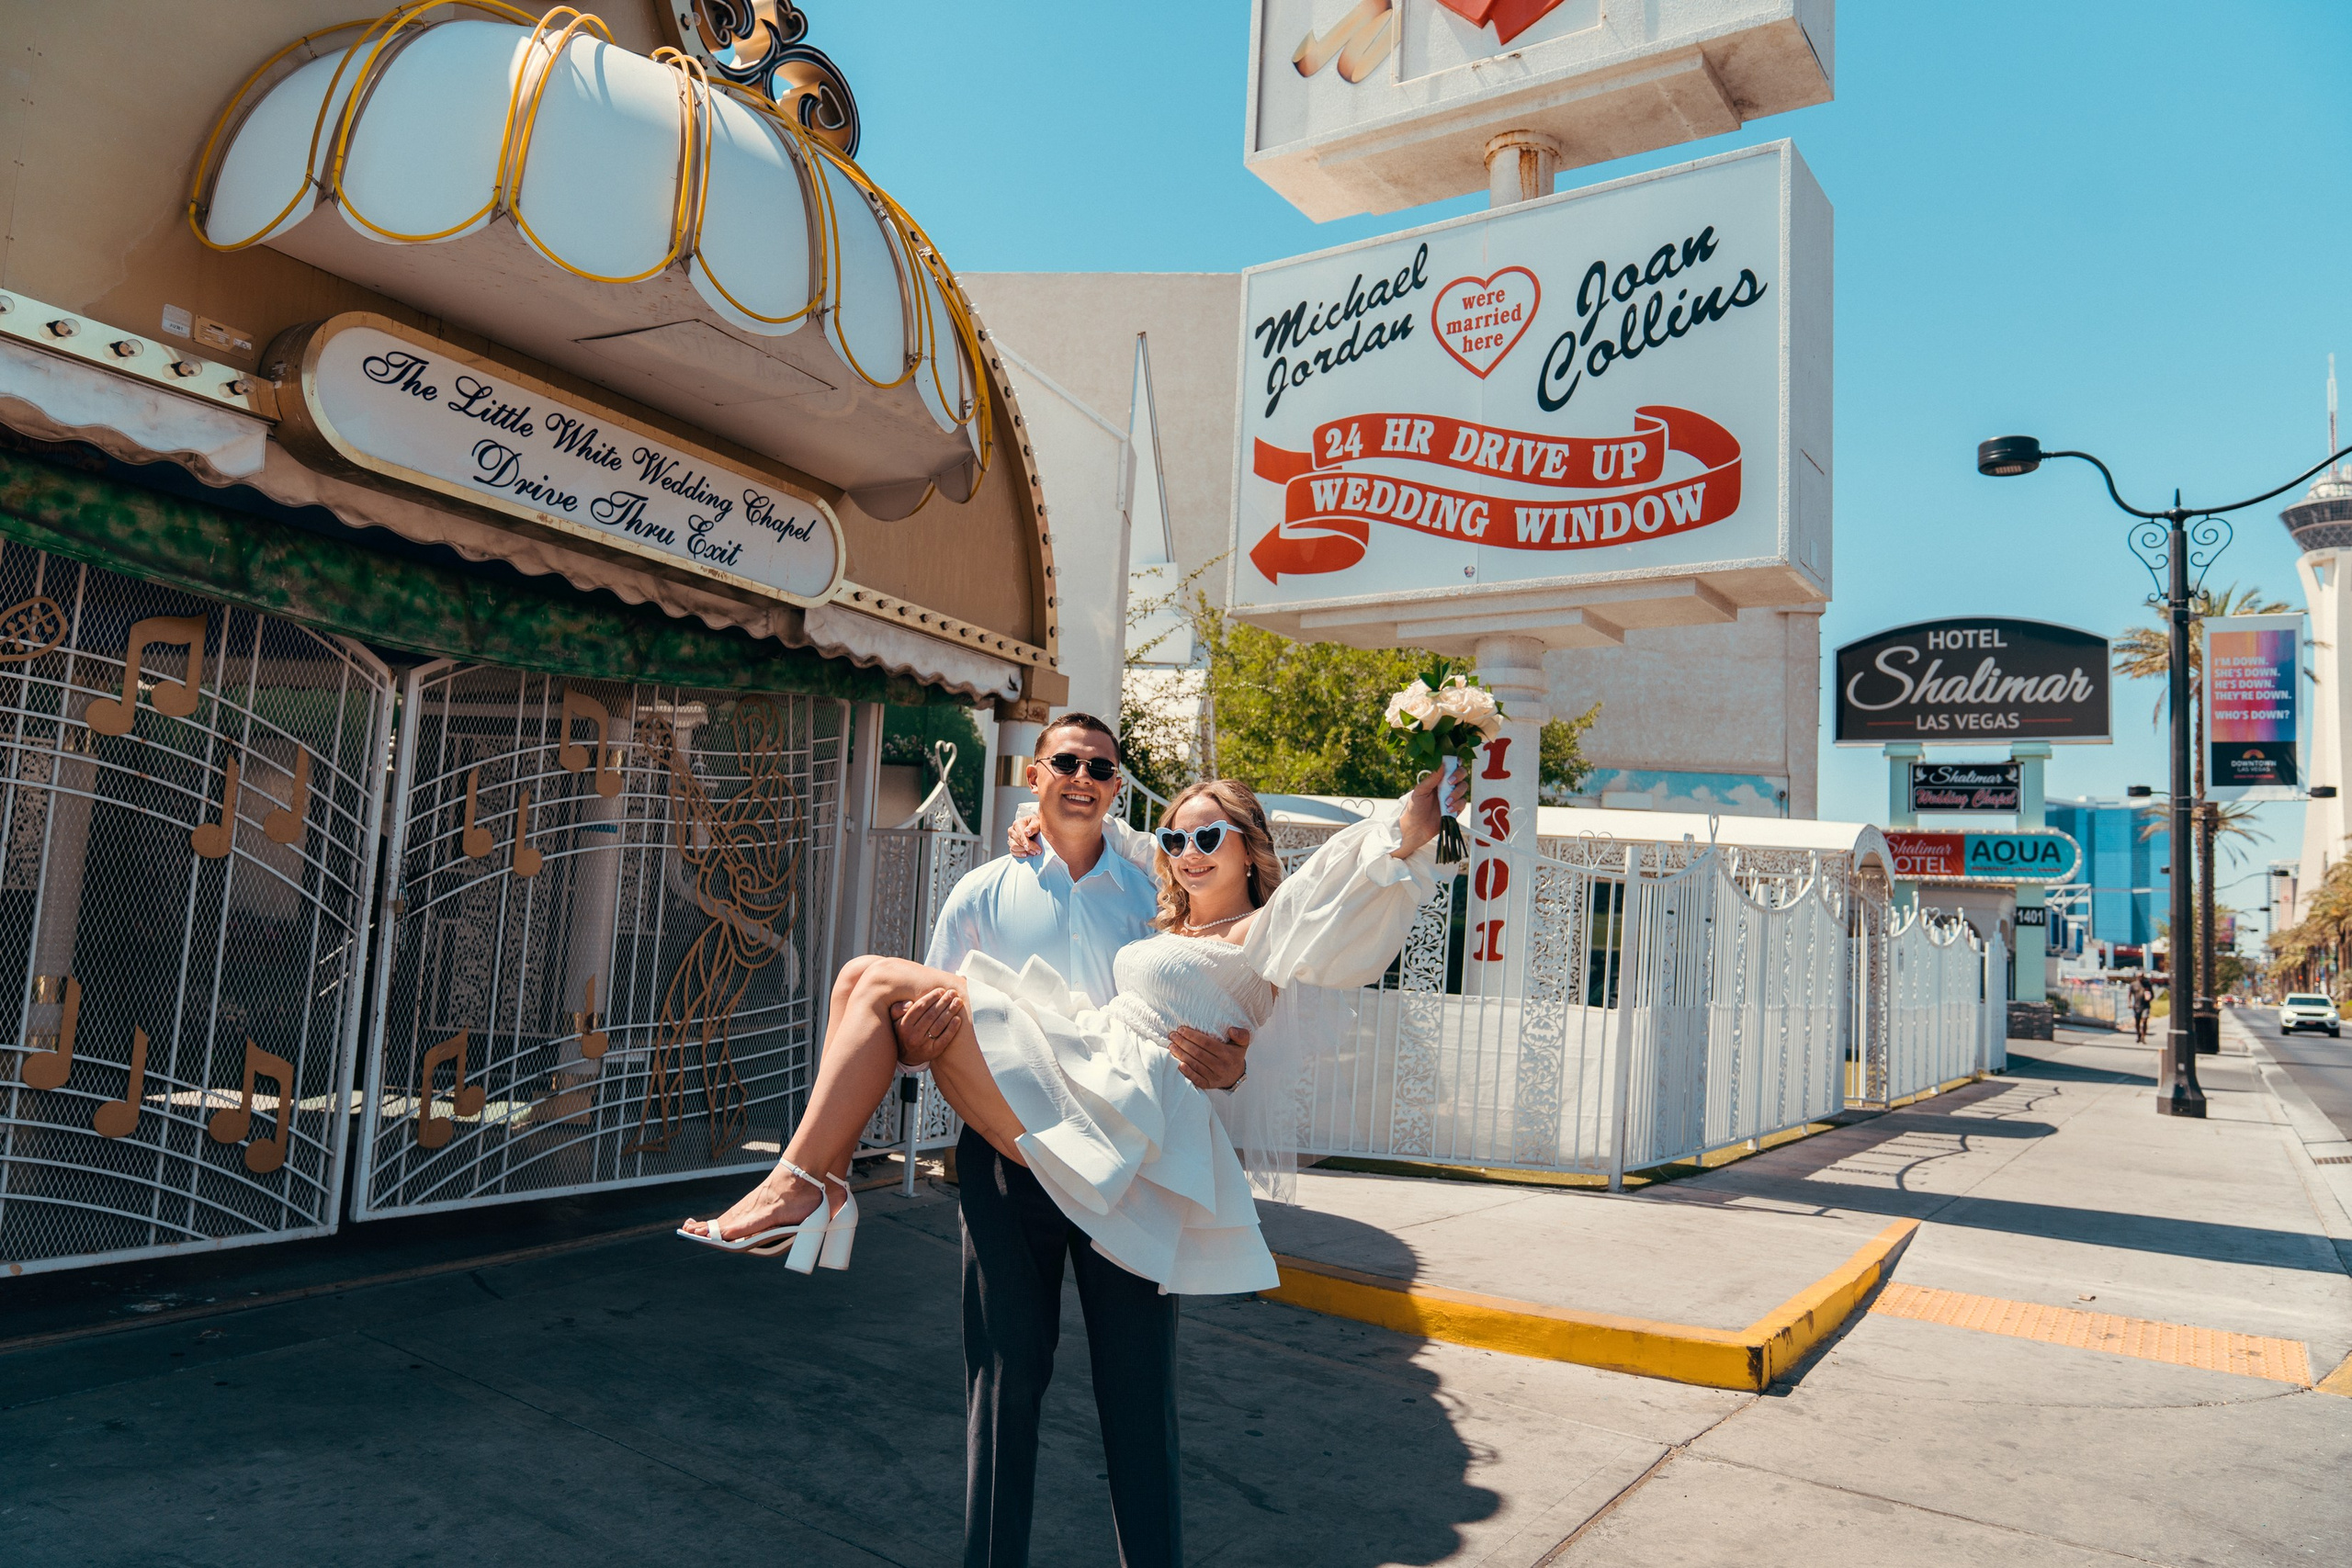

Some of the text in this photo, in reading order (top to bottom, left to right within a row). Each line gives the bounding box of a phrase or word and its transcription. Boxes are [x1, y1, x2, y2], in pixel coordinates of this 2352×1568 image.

[1576, 226, 1719, 346] Joan
[1255, 243, 1429, 358] Michael
[1462, 289, 1506, 310] were
[1446, 303, 1522, 335] married
[1462, 332, 1504, 354] here
[1537, 267, 1768, 412] Collins
[1264, 313, 1415, 418] Jordan
[362, 351, 817, 543] The Little White Wedding Chapel
[1325, 418, 1647, 480] 24 HR DRIVE UP
[471, 439, 743, 567] Drive Thru Exit
[1309, 477, 1707, 545] WEDDING WINDOW
[1928, 628, 2008, 649] HOTEL
[2214, 657, 2269, 666] I'M DOWN.
[1846, 645, 2095, 711] Shalimar
[2214, 668, 2281, 678] SHE'S DOWN.
[2214, 679, 2276, 690] HE'S DOWN.
[2214, 691, 2292, 701] THEY'RE DOWN.
[1916, 712, 2019, 730] LAS VEGAS
[2214, 709, 2290, 720] WHO'S DOWN?
[1928, 765, 2004, 784] Shalimar
[1916, 787, 2017, 809] Wedding Chapel
[1886, 834, 1953, 854] Shalimar
[1971, 840, 2062, 865] AQUA
[1894, 855, 1952, 874] OTEL
[2018, 908, 2043, 924] 1401
